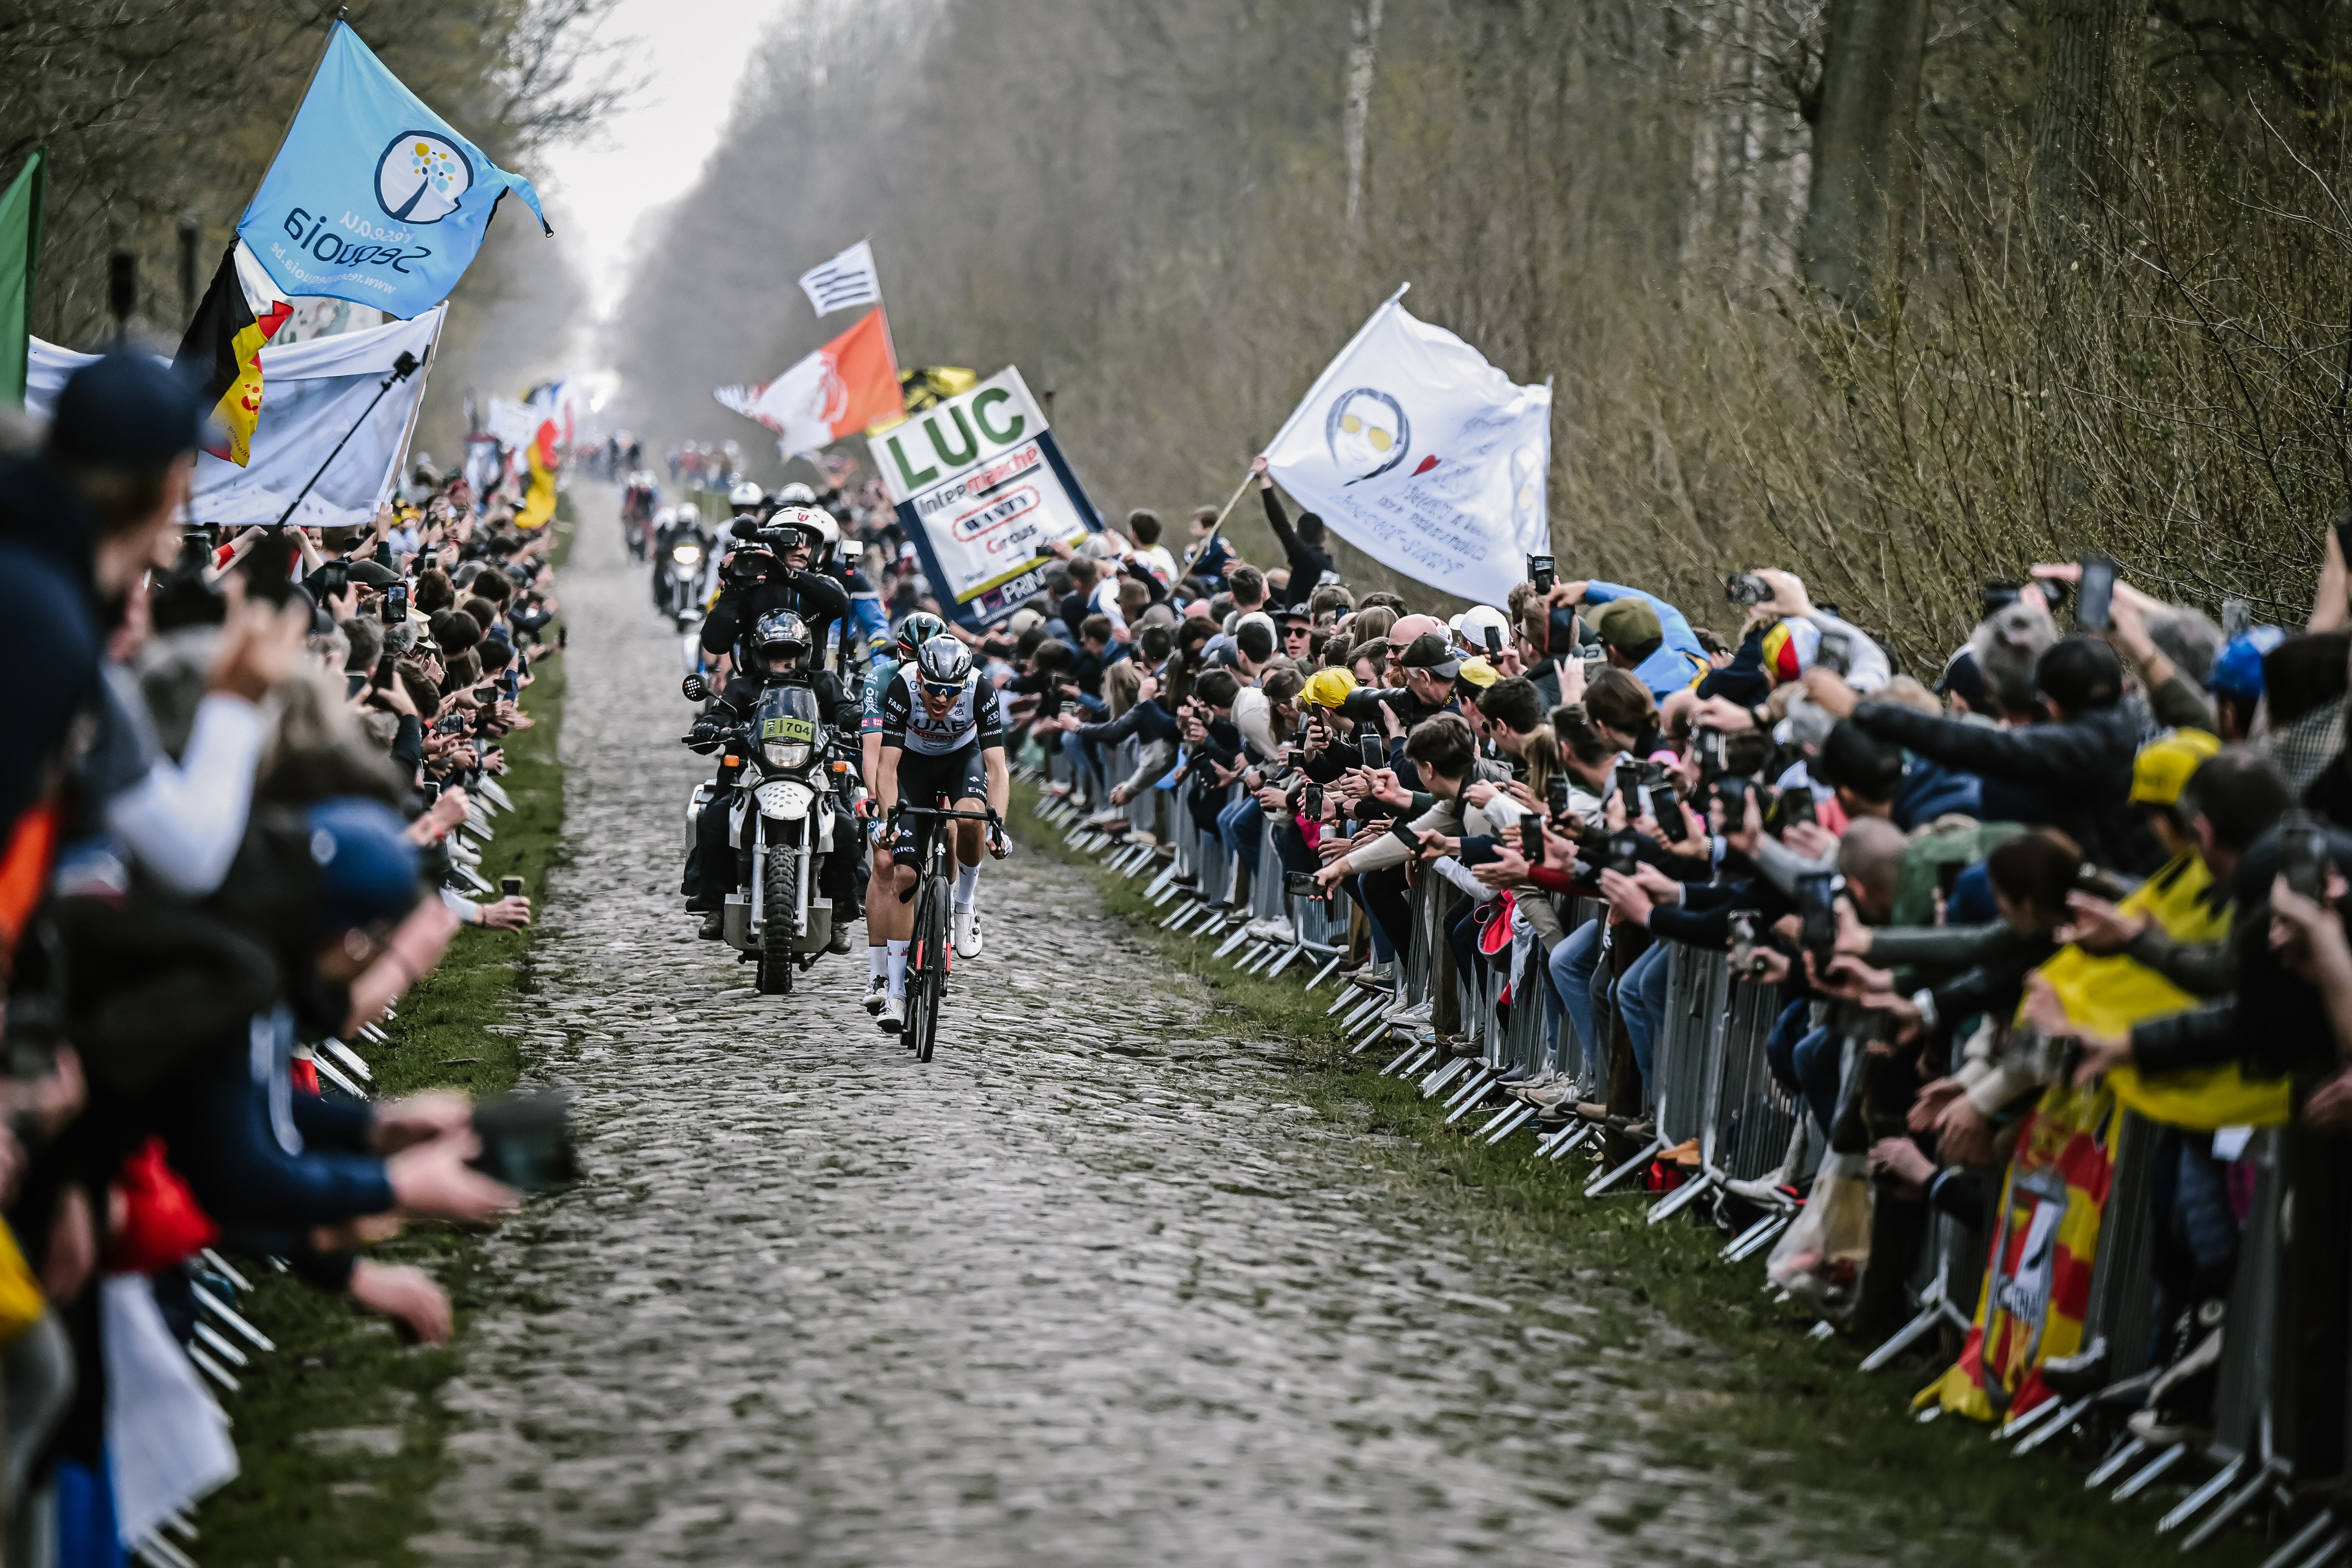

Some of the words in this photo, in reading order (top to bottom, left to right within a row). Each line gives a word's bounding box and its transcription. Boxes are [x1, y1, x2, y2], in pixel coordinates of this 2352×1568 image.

[887, 387, 1024, 492] LUC
[1000, 565, 1046, 604] PRIN
[786, 722, 810, 735] 704
[913, 718, 967, 733] UAE
